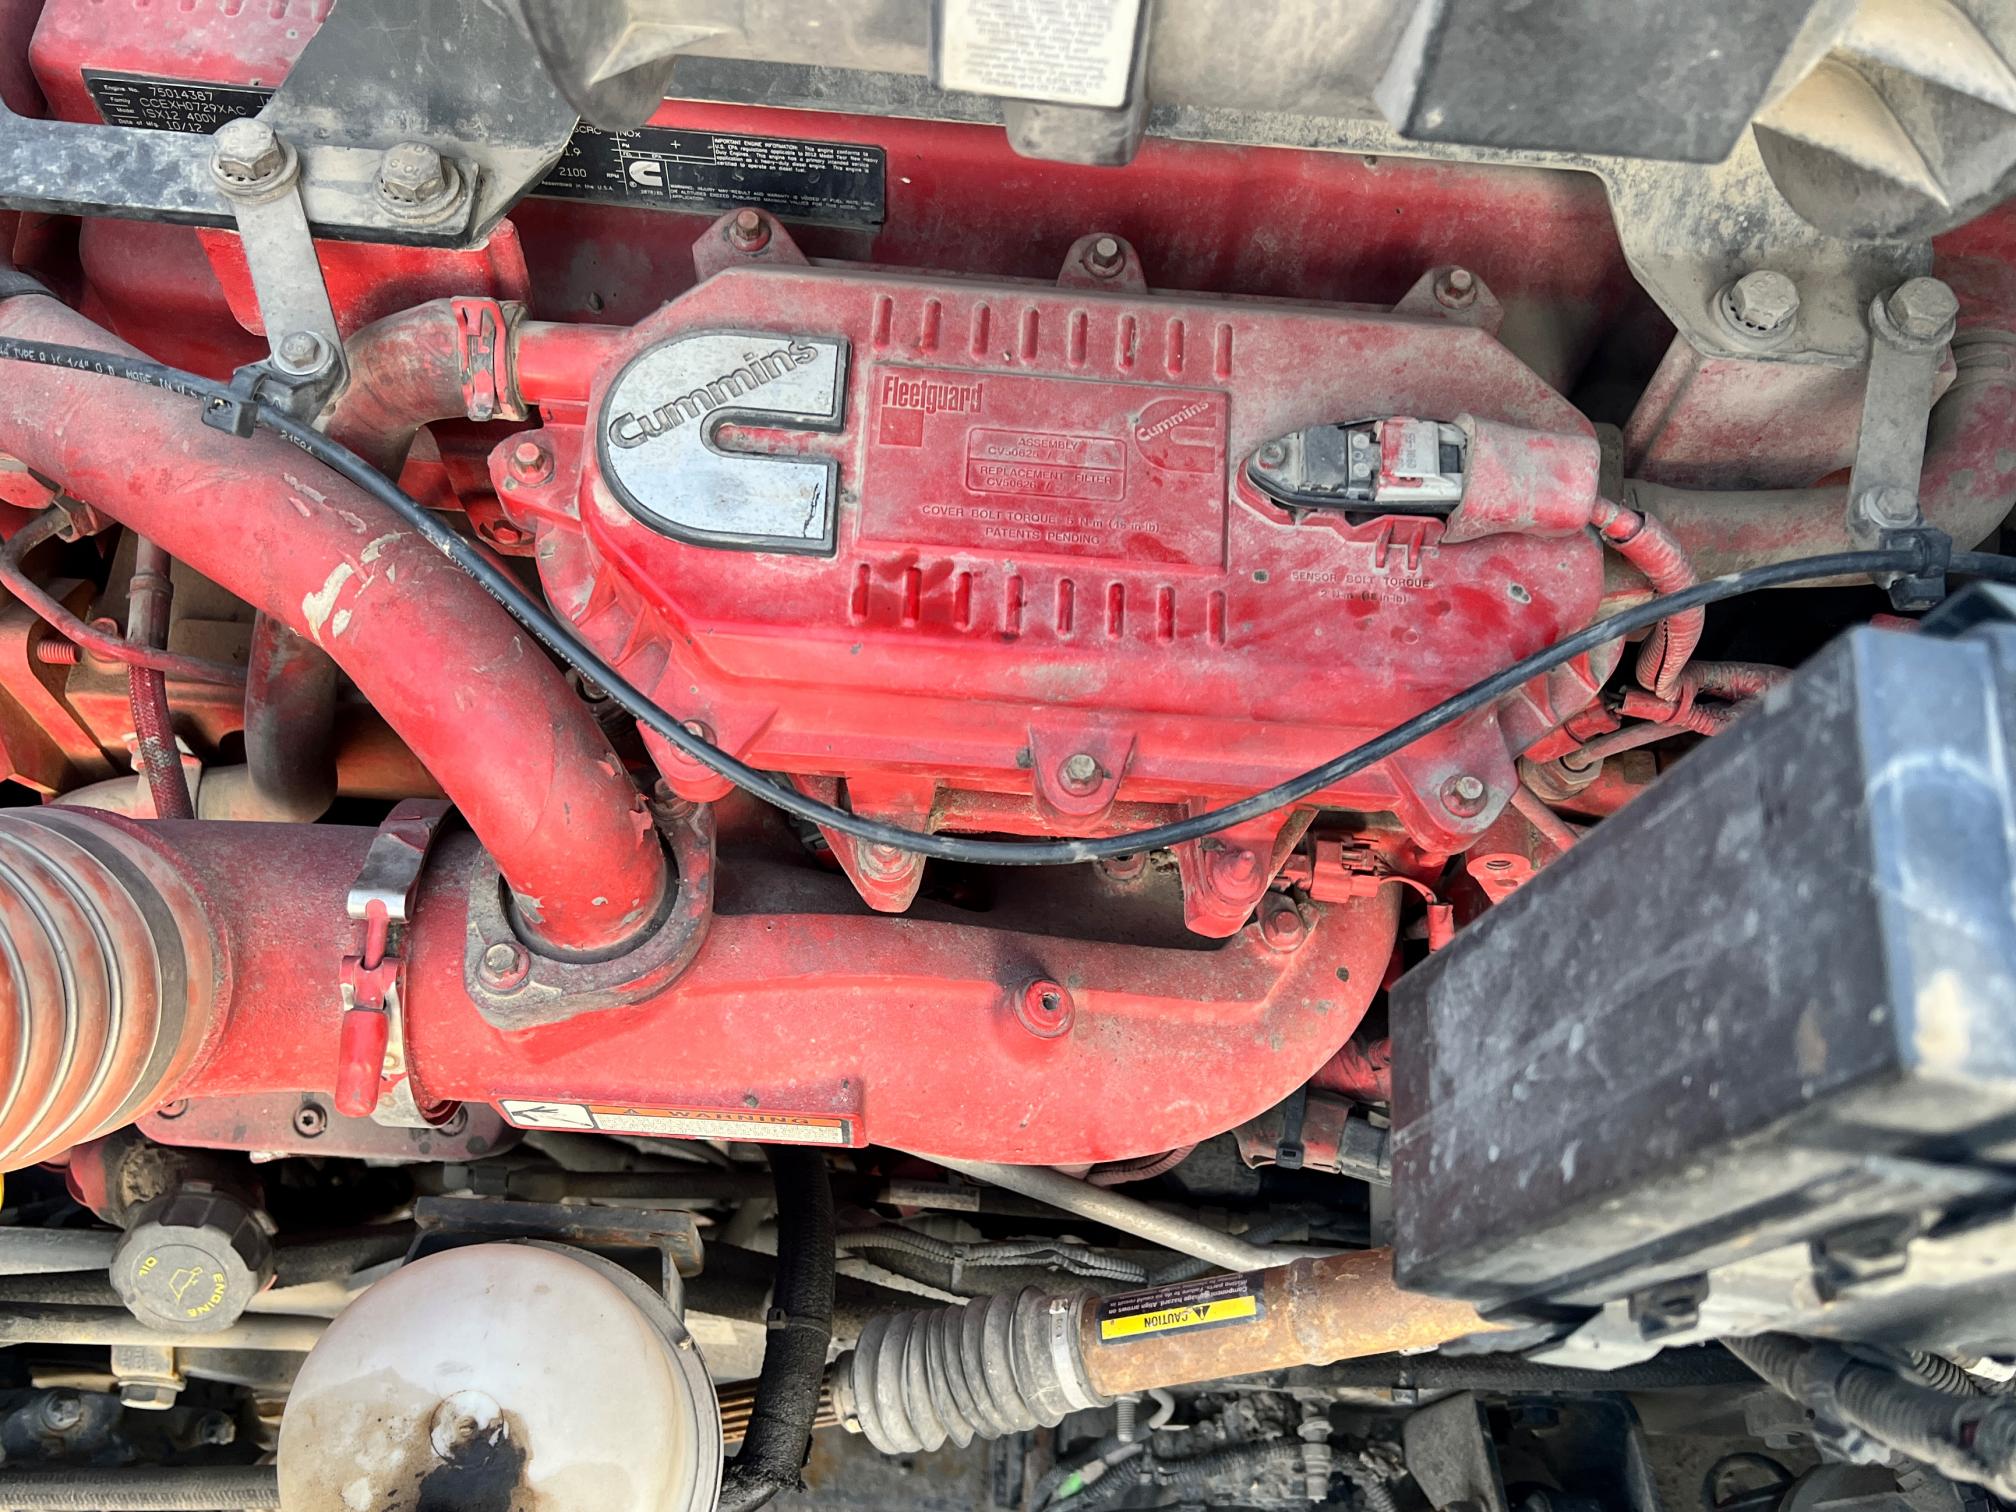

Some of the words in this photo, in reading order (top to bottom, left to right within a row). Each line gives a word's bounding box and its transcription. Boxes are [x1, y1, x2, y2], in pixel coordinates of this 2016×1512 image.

[148, 87, 213, 101] 75014387
[140, 98, 246, 116] CCEXH0729XAC
[142, 108, 180, 121] ISX12
[186, 111, 217, 123] 400V
[166, 121, 203, 133] 10/12
[559, 167, 587, 178] 2100
[608, 340, 818, 449] Cummins
[882, 375, 983, 414] Fleetguard
[1136, 401, 1209, 441] Cummins
[1017, 437, 1078, 450] ASSEMBLY
[980, 465, 1064, 481] REPLACEMENT
[1074, 474, 1112, 485] FILTER
[922, 505, 964, 517] COVER
[971, 509, 1002, 520] BOLT
[985, 526, 1040, 540] PATENTS
[1047, 531, 1100, 545] PENDING
[1291, 571, 1337, 582] SENSOR
[1345, 575, 1374, 584] BOLT
[669, 1111, 809, 1125] WARNING
[138, 1256, 158, 1278] OIL
[187, 1272, 226, 1318] ENGINE
[1144, 1311, 1188, 1328] CAUTION
